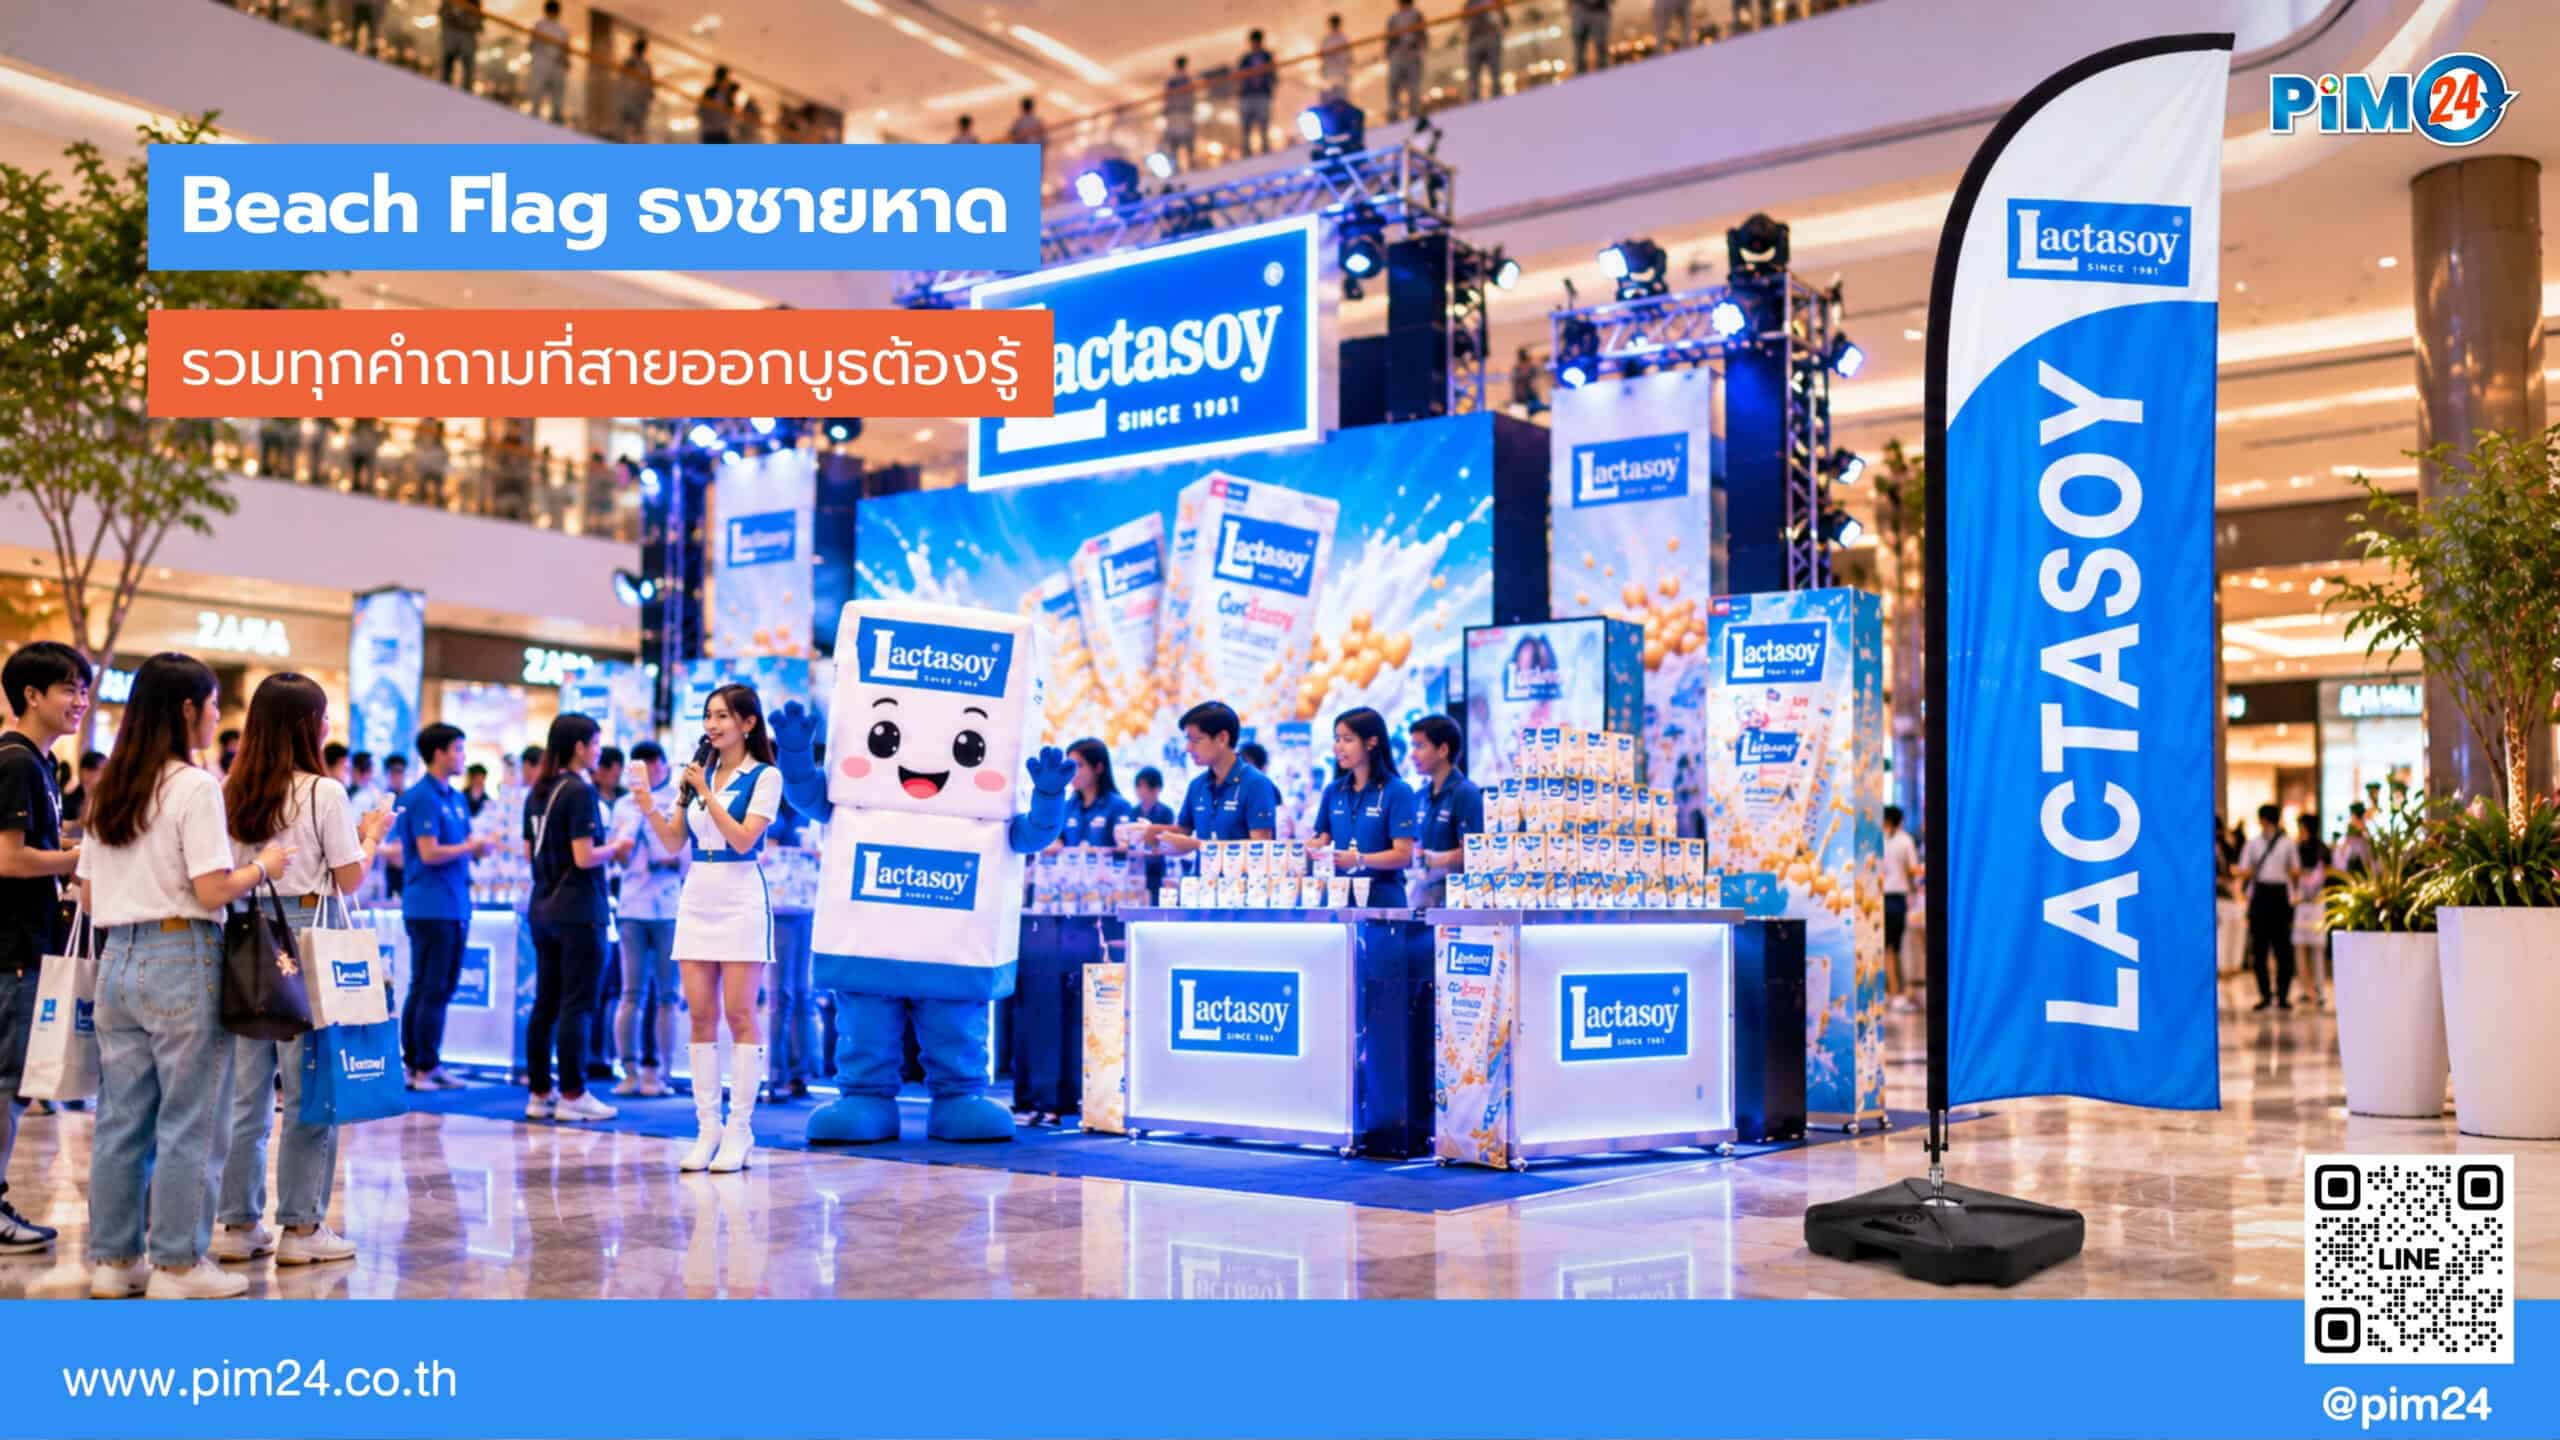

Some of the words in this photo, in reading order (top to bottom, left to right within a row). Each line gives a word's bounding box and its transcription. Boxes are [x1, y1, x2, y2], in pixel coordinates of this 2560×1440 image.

[2017, 209, 2181, 272] Lactasoy
[2087, 262, 2124, 273] SINCE
[1117, 403, 1182, 432] SINCE
[1193, 395, 1239, 420] 1981
[1578, 450, 1681, 501] Lactasoy
[869, 629, 998, 681] Lactasoy
[1731, 633, 1820, 678] Lactasoy
[2038, 359, 2144, 1032] LACTASOY
[860, 850, 969, 898] Lactasoy
[1178, 979, 1290, 1041] Lactasoy
[1569, 985, 1680, 1050] Lactasoy
